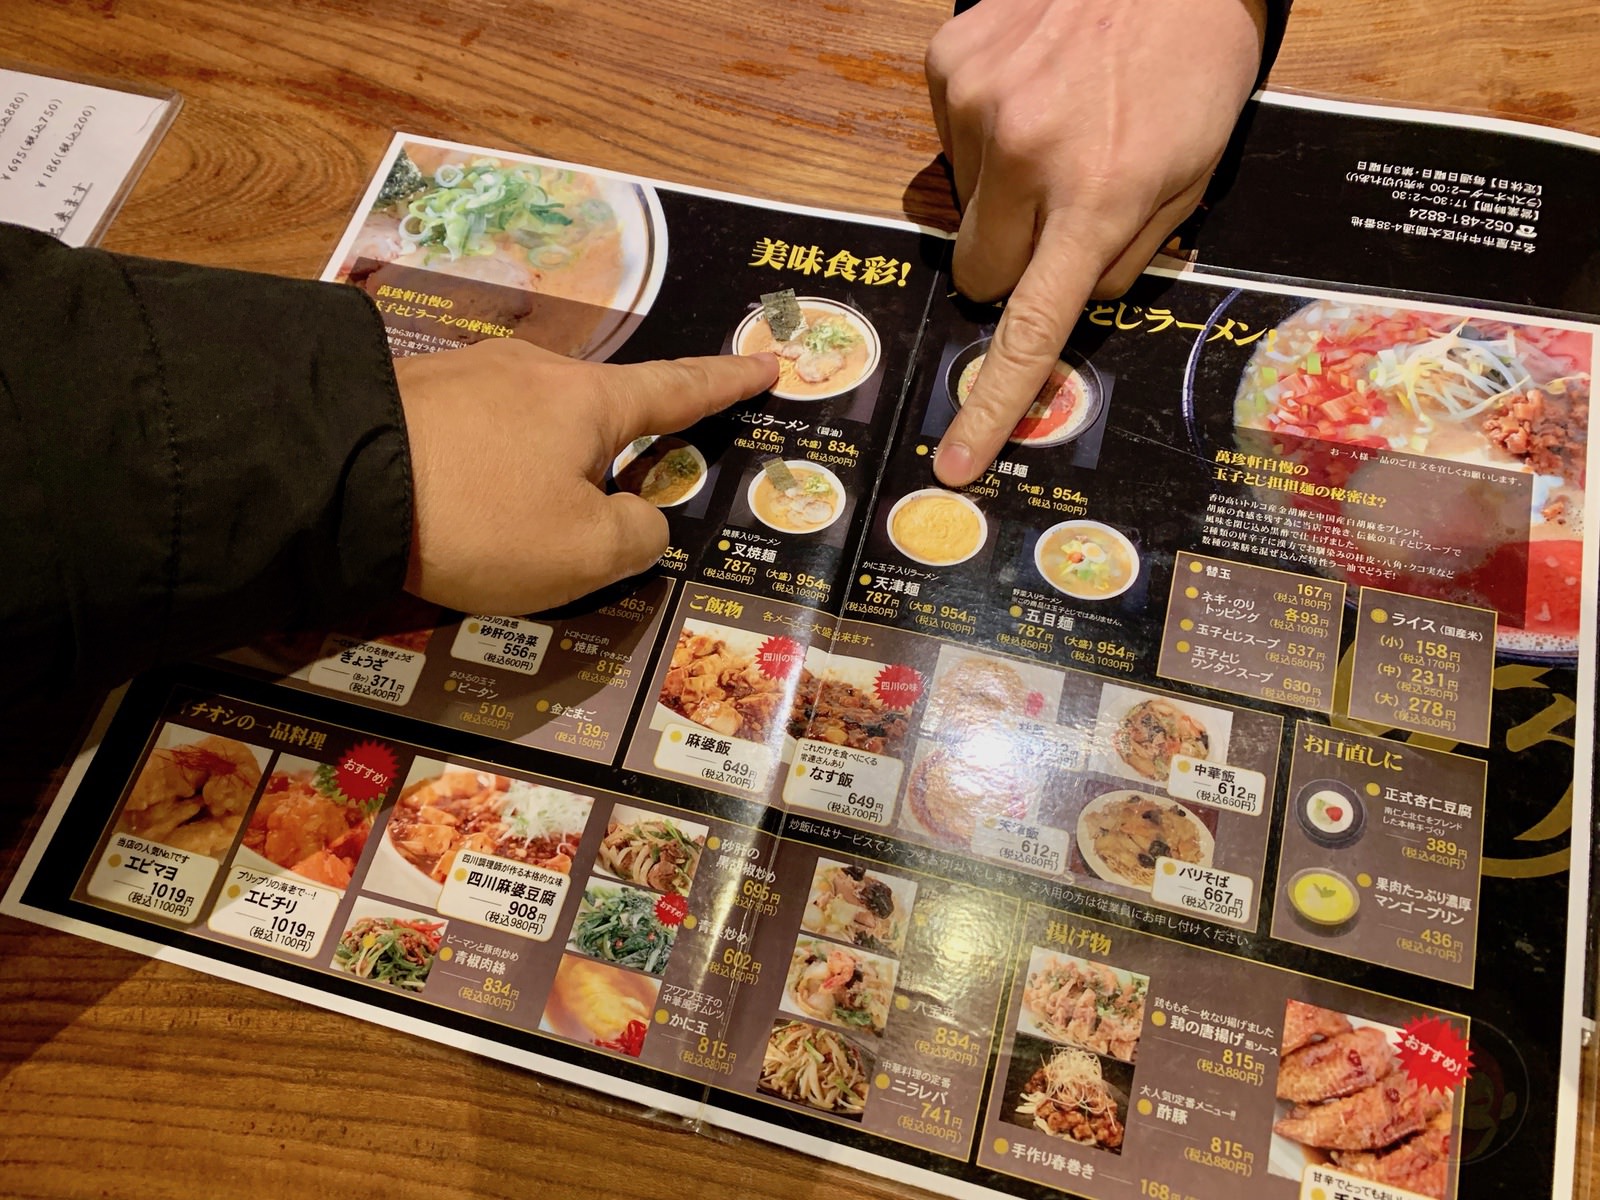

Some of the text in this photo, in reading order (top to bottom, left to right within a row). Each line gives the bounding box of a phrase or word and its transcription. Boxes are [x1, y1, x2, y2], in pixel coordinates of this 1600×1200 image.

[1409, 208, 1514, 233] 052-481-8824
[748, 237, 912, 287] 美味食彩!
[377, 285, 454, 309] 萬珍軒自慢の
[752, 428, 859, 458] 676円 (大盛) 834円
[1215, 449, 1310, 476] 萬珍軒自慢の
[1017, 482, 1089, 506] (大盛) 954円
[1212, 466, 1387, 508] 玉子とじ担担麺の秘密は?
[721, 528, 782, 546] 焼豚入りラーメン
[731, 542, 778, 564] 叉焼麺
[702, 567, 755, 585] (税込850円)
[723, 557, 832, 593] 787円 (大盛) 954円
[862, 561, 940, 581] かに玉子入りラーメン
[1206, 565, 1332, 601] 替玉 167円
[872, 575, 921, 597] 天津麺
[1012, 588, 1063, 605] 野菜入りラーメン
[620, 597, 654, 615] 463円
[689, 594, 745, 619] ご飯物
[844, 602, 898, 618] (税込850円)
[865, 590, 977, 625] 787円 (大盛) 954円
[1202, 591, 1329, 627] ネギ・のり 各93円
[1205, 604, 1260, 623] トッピング
[1273, 592, 1332, 611] (税込180円)
[1024, 608, 1075, 632] 五目麺
[1269, 619, 1328, 638] (税込100円)
[1391, 612, 1483, 642] ライス (国産米)
[480, 624, 539, 648] 砂肝の冷菜
[573, 641, 598, 656] 焼豚
[996, 632, 1053, 654] (税込850円)
[1017, 622, 1135, 661] 787円 (大盛) 954円
[1196, 623, 1325, 661] 玉子とじスープ 537円
[1380, 634, 1460, 662] (小) 158円
[340, 651, 389, 672] ぎょうざ
[483, 652, 534, 671] (税込600円)
[502, 643, 537, 661] 556円
[1193, 645, 1240, 664] 玉子とじ
[1399, 652, 1460, 672] (税込170円)
[596, 659, 632, 679] 815円
[1191, 658, 1274, 683] ワンタンスープ
[1377, 663, 1458, 691] (中) 231円
[349, 683, 401, 702] (税込400円)
[370, 674, 405, 694] 371円
[880, 680, 918, 693] 四川の味
[1283, 678, 1321, 697] 630円
[1396, 681, 1458, 701] (税込250円)
[479, 701, 514, 721] 510円
[550, 702, 597, 722] 金たまご
[1375, 691, 1456, 720] (大) 278円
[575, 721, 610, 741] 139円
[684, 732, 731, 756] 麻婆飯
[802, 742, 878, 767] これだけを食べにくる
[1303, 734, 1404, 772] お口直しに
[343, 758, 388, 787] おすすめ!
[722, 759, 758, 780] 649円
[800, 753, 845, 769] 常連さんあり
[1194, 763, 1236, 784] 中華飯
[701, 767, 756, 790] (税込700円)
[808, 765, 854, 789] なす飯
[847, 792, 884, 813] 649円
[1218, 781, 1257, 802] 612円
[1384, 786, 1473, 819] 正式杏仁豆腐
[826, 800, 883, 824] (税込700円)
[1382, 815, 1445, 837] した本格手づくり
[721, 839, 760, 860] 砂肝の
[1021, 840, 1059, 860] 612円
[1401, 846, 1466, 871] (税込420円)
[1426, 837, 1467, 860] 389円
[124, 855, 178, 882] エビマヨ
[462, 853, 564, 888] 四川調理師が作る本格的な味
[150, 882, 195, 907] 1019円
[466, 871, 557, 907] 四川麻婆豆腐
[743, 879, 781, 905] 695円
[1204, 887, 1243, 909] 667円
[1375, 876, 1473, 912] 果肉たっぷり濃厚
[127, 891, 190, 918] (税込1100円)
[244, 890, 298, 915] エビチリ
[508, 901, 547, 924] 908円
[1181, 894, 1243, 919] (税込720円)
[1374, 893, 1465, 926] マンゴープリン
[270, 916, 316, 942] 1019円
[484, 910, 544, 935] (税込980円)
[249, 926, 312, 953] (税込1100円)
[446, 933, 519, 962] ピーマンと豚肉炒め
[1046, 920, 1113, 956] 揚げ物
[1396, 937, 1462, 964] (税込470円)
[1420, 929, 1463, 952] 436円
[723, 948, 762, 974] 602円
[458, 986, 516, 1012] (税込900円)
[483, 977, 520, 1000] 834円
[669, 1013, 709, 1036] かに玉
[1170, 1015, 1245, 1046] 鶏の唐揚げ
[697, 1037, 737, 1063] 815円
[935, 1026, 980, 1055] 834円
[1222, 1048, 1265, 1075] 815円
[1404, 1033, 1463, 1076] おすすめ!
[881, 1060, 951, 1089] 中華料理の定番
[1196, 1058, 1263, 1087] (税込880円)
[891, 1079, 949, 1105] ニラレバ
[921, 1102, 963, 1129] 741円
[1156, 1103, 1189, 1126] 酢豚
[1011, 1143, 1096, 1181] 手作り春巻き
[1184, 1146, 1253, 1177] (税込880円)
[1210, 1136, 1254, 1164] 815円
